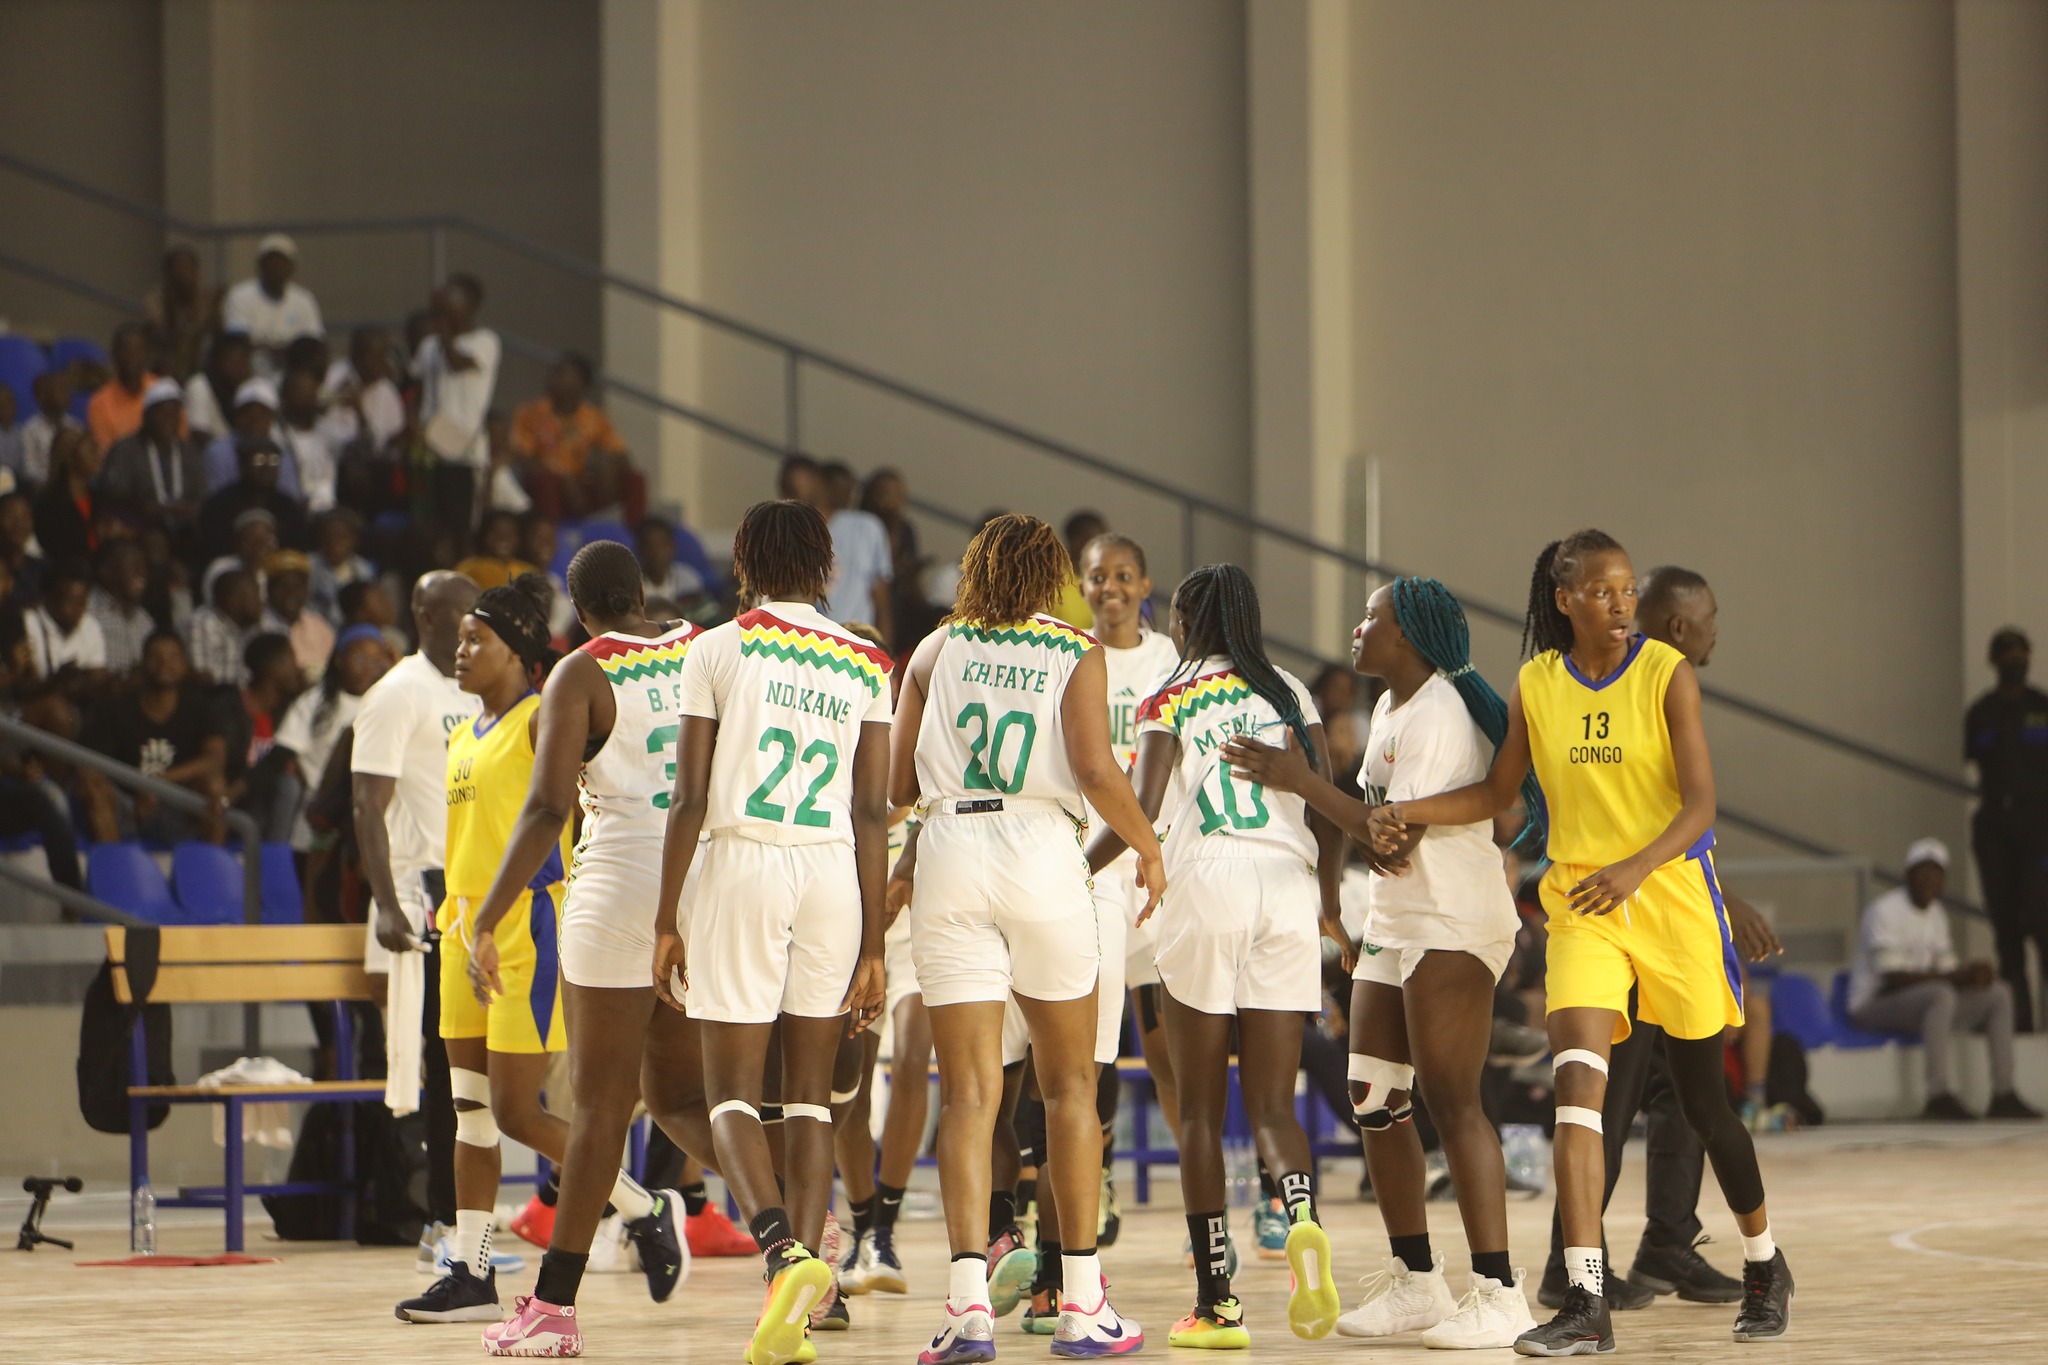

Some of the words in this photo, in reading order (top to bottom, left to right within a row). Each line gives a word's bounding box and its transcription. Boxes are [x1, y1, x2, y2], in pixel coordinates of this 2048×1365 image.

[962, 660, 1049, 693] KH.FAYE
[765, 680, 852, 725] ND.KANE
[1582, 712, 1610, 740] 13
[956, 702, 1037, 795] 20
[1570, 746, 1622, 764] CONGO
[446, 785, 476, 806] CONGO
[744, 726, 839, 828] 22
[1196, 759, 1270, 837] 10
